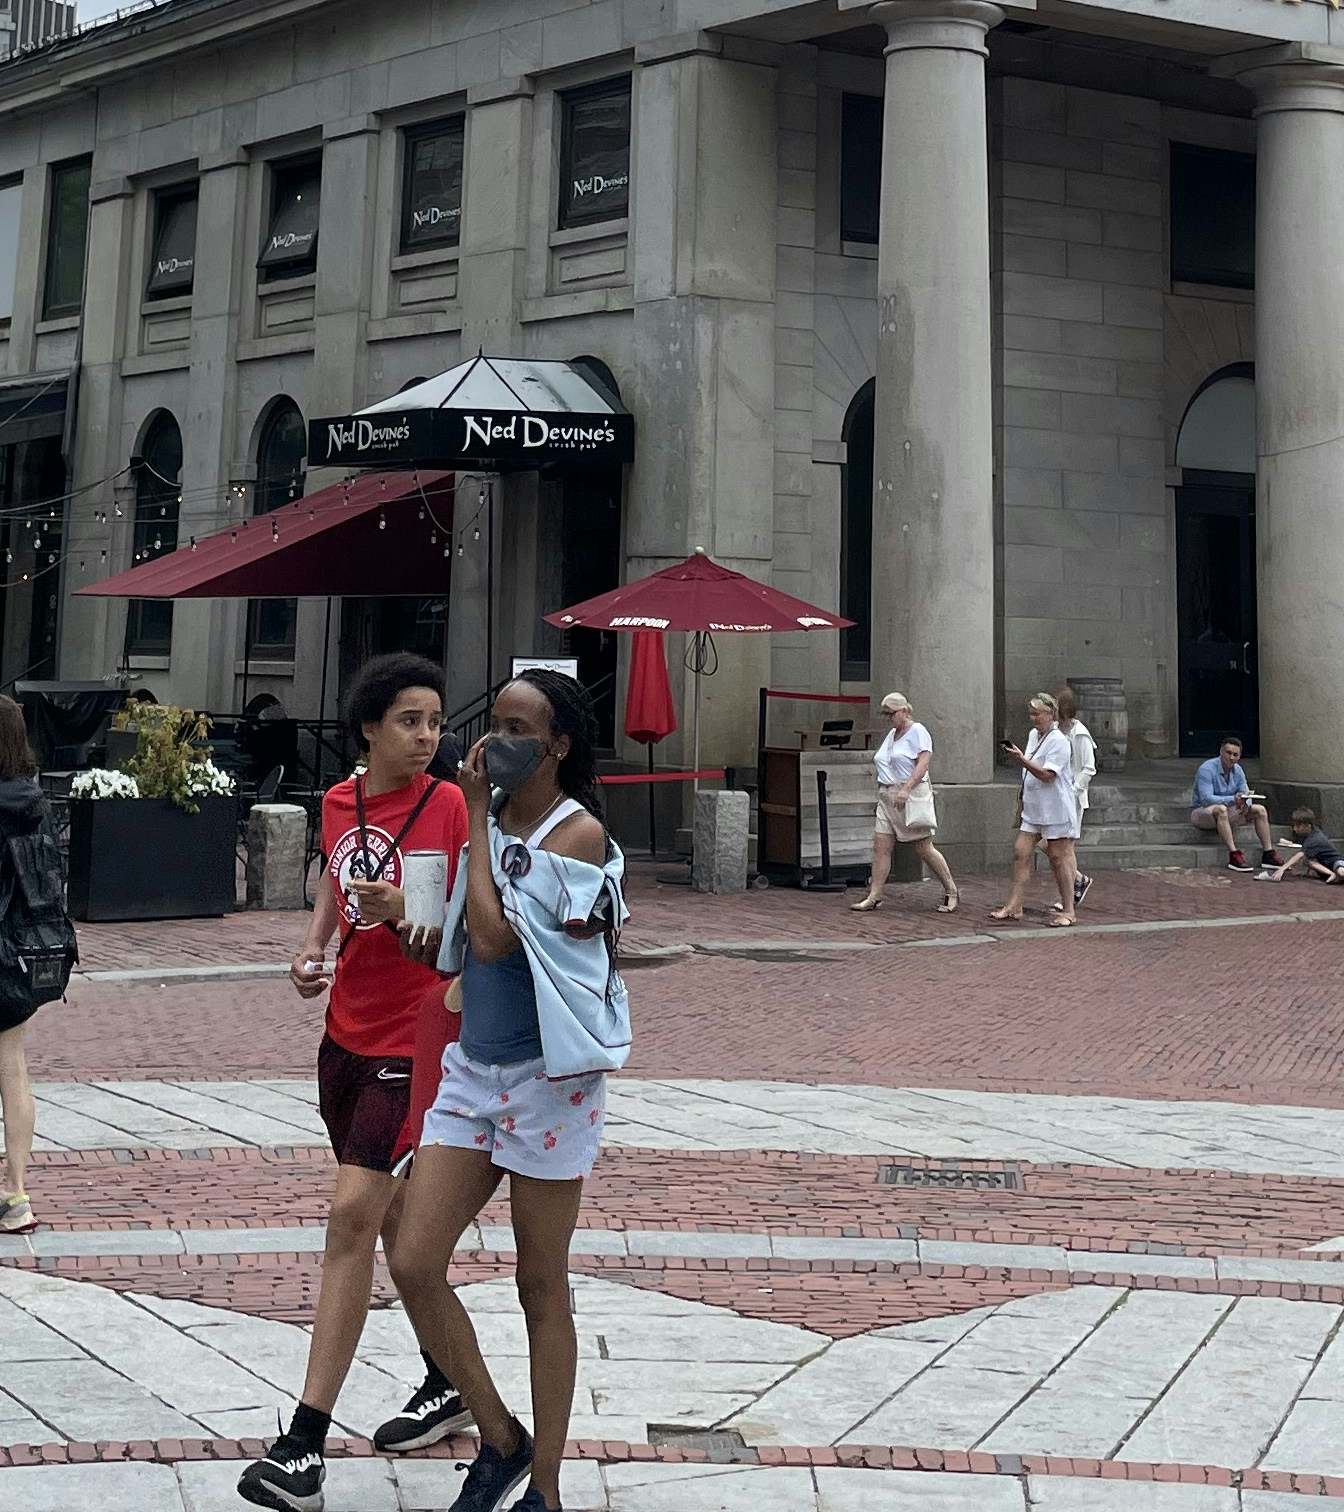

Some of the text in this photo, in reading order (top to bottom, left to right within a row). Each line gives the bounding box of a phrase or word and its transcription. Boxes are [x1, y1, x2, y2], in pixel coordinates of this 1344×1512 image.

[326, 420, 356, 459] Ned
[462, 415, 516, 452] Ned
[609, 616, 671, 629] HARPOON
[330, 835, 358, 877] JUNIOR
